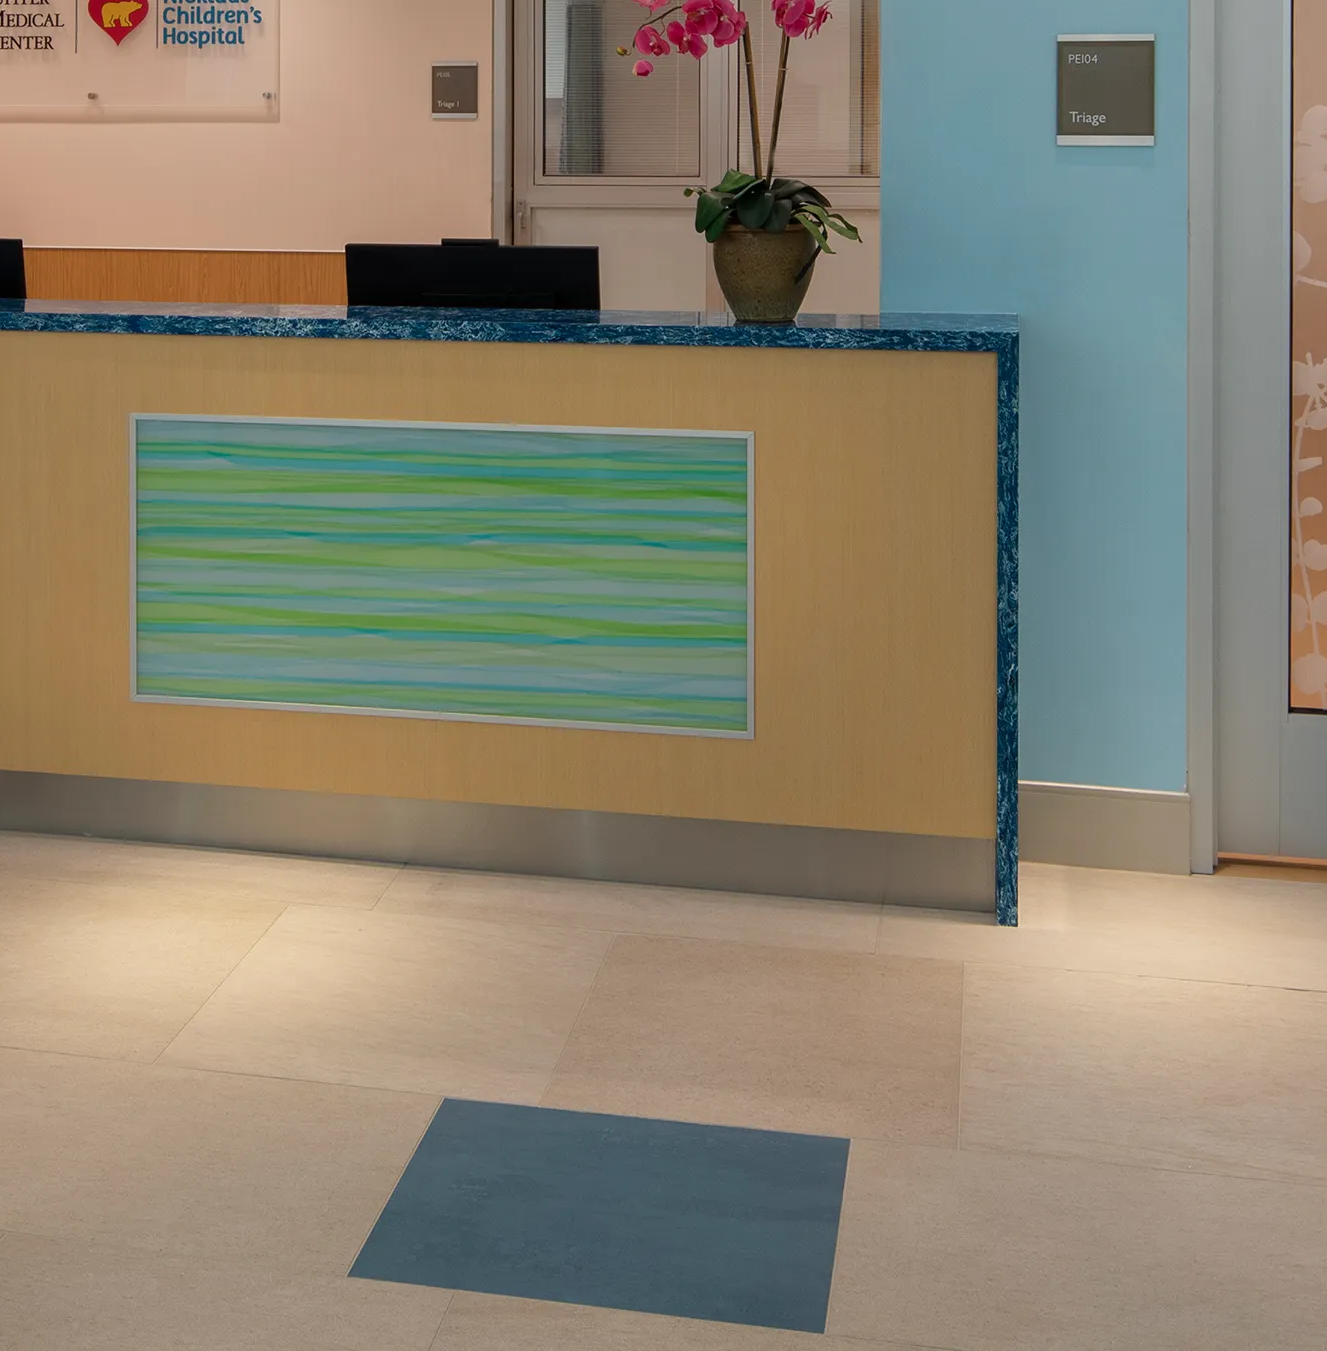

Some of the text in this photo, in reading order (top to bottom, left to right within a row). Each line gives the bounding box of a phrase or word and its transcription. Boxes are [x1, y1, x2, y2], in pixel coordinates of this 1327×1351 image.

[163, 26, 245, 48] Hospital
[437, 100, 455, 109] Triage
[1069, 111, 1107, 126] Triage
